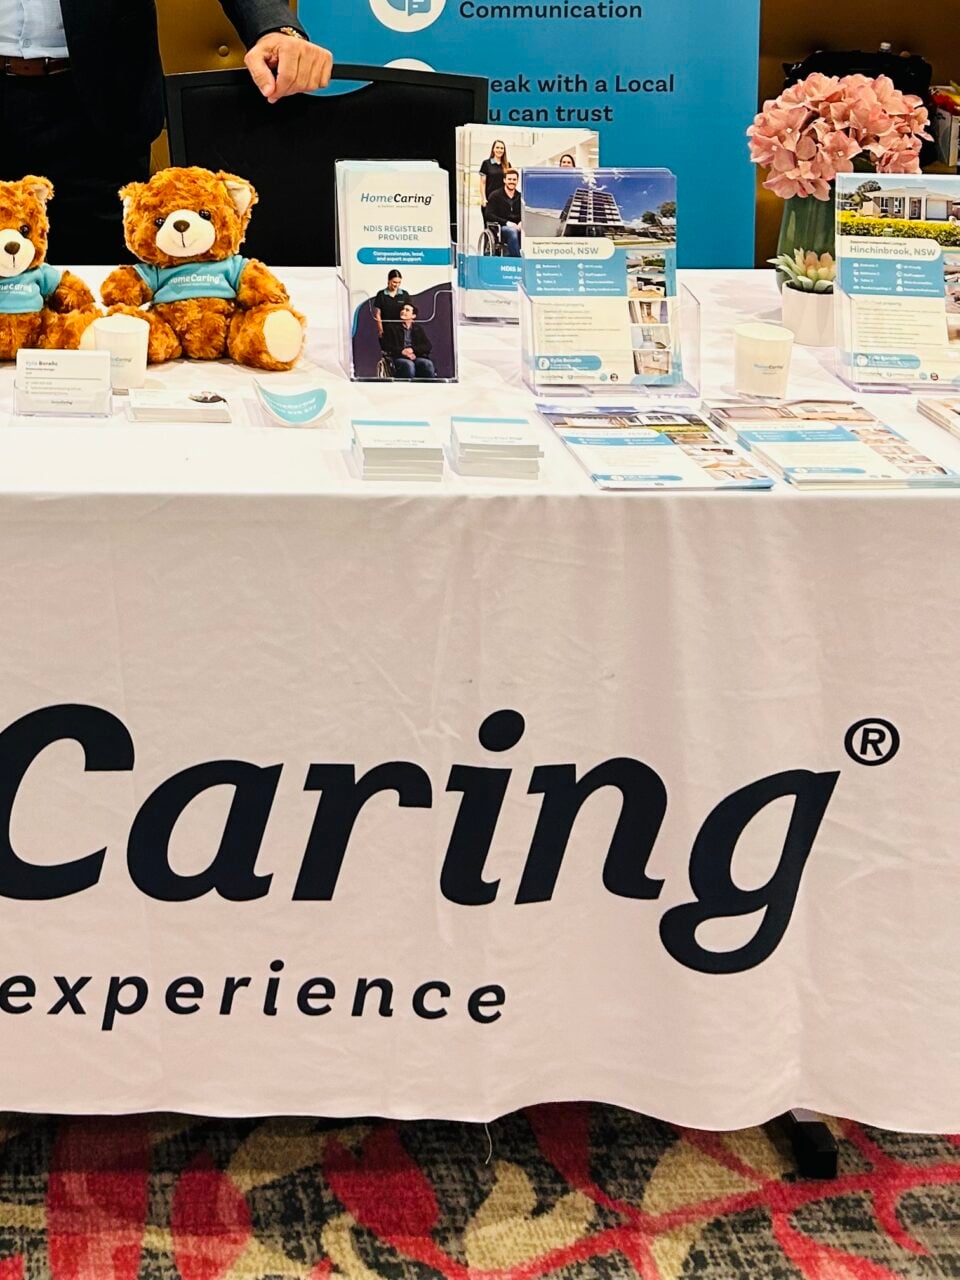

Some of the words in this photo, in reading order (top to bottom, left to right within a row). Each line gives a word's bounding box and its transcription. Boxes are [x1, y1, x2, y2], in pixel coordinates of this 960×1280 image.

[459, 0, 642, 18] Communication
[490, 74, 530, 93] eak
[537, 74, 587, 93] with
[595, 79, 608, 93] a
[616, 74, 674, 93] Local
[509, 108, 548, 122] can
[556, 105, 613, 122] trust
[533, 247, 576, 256] Liverpool,
[850, 245, 912, 256] Hinchinbrook,
[914, 248, 936, 256] NSW
